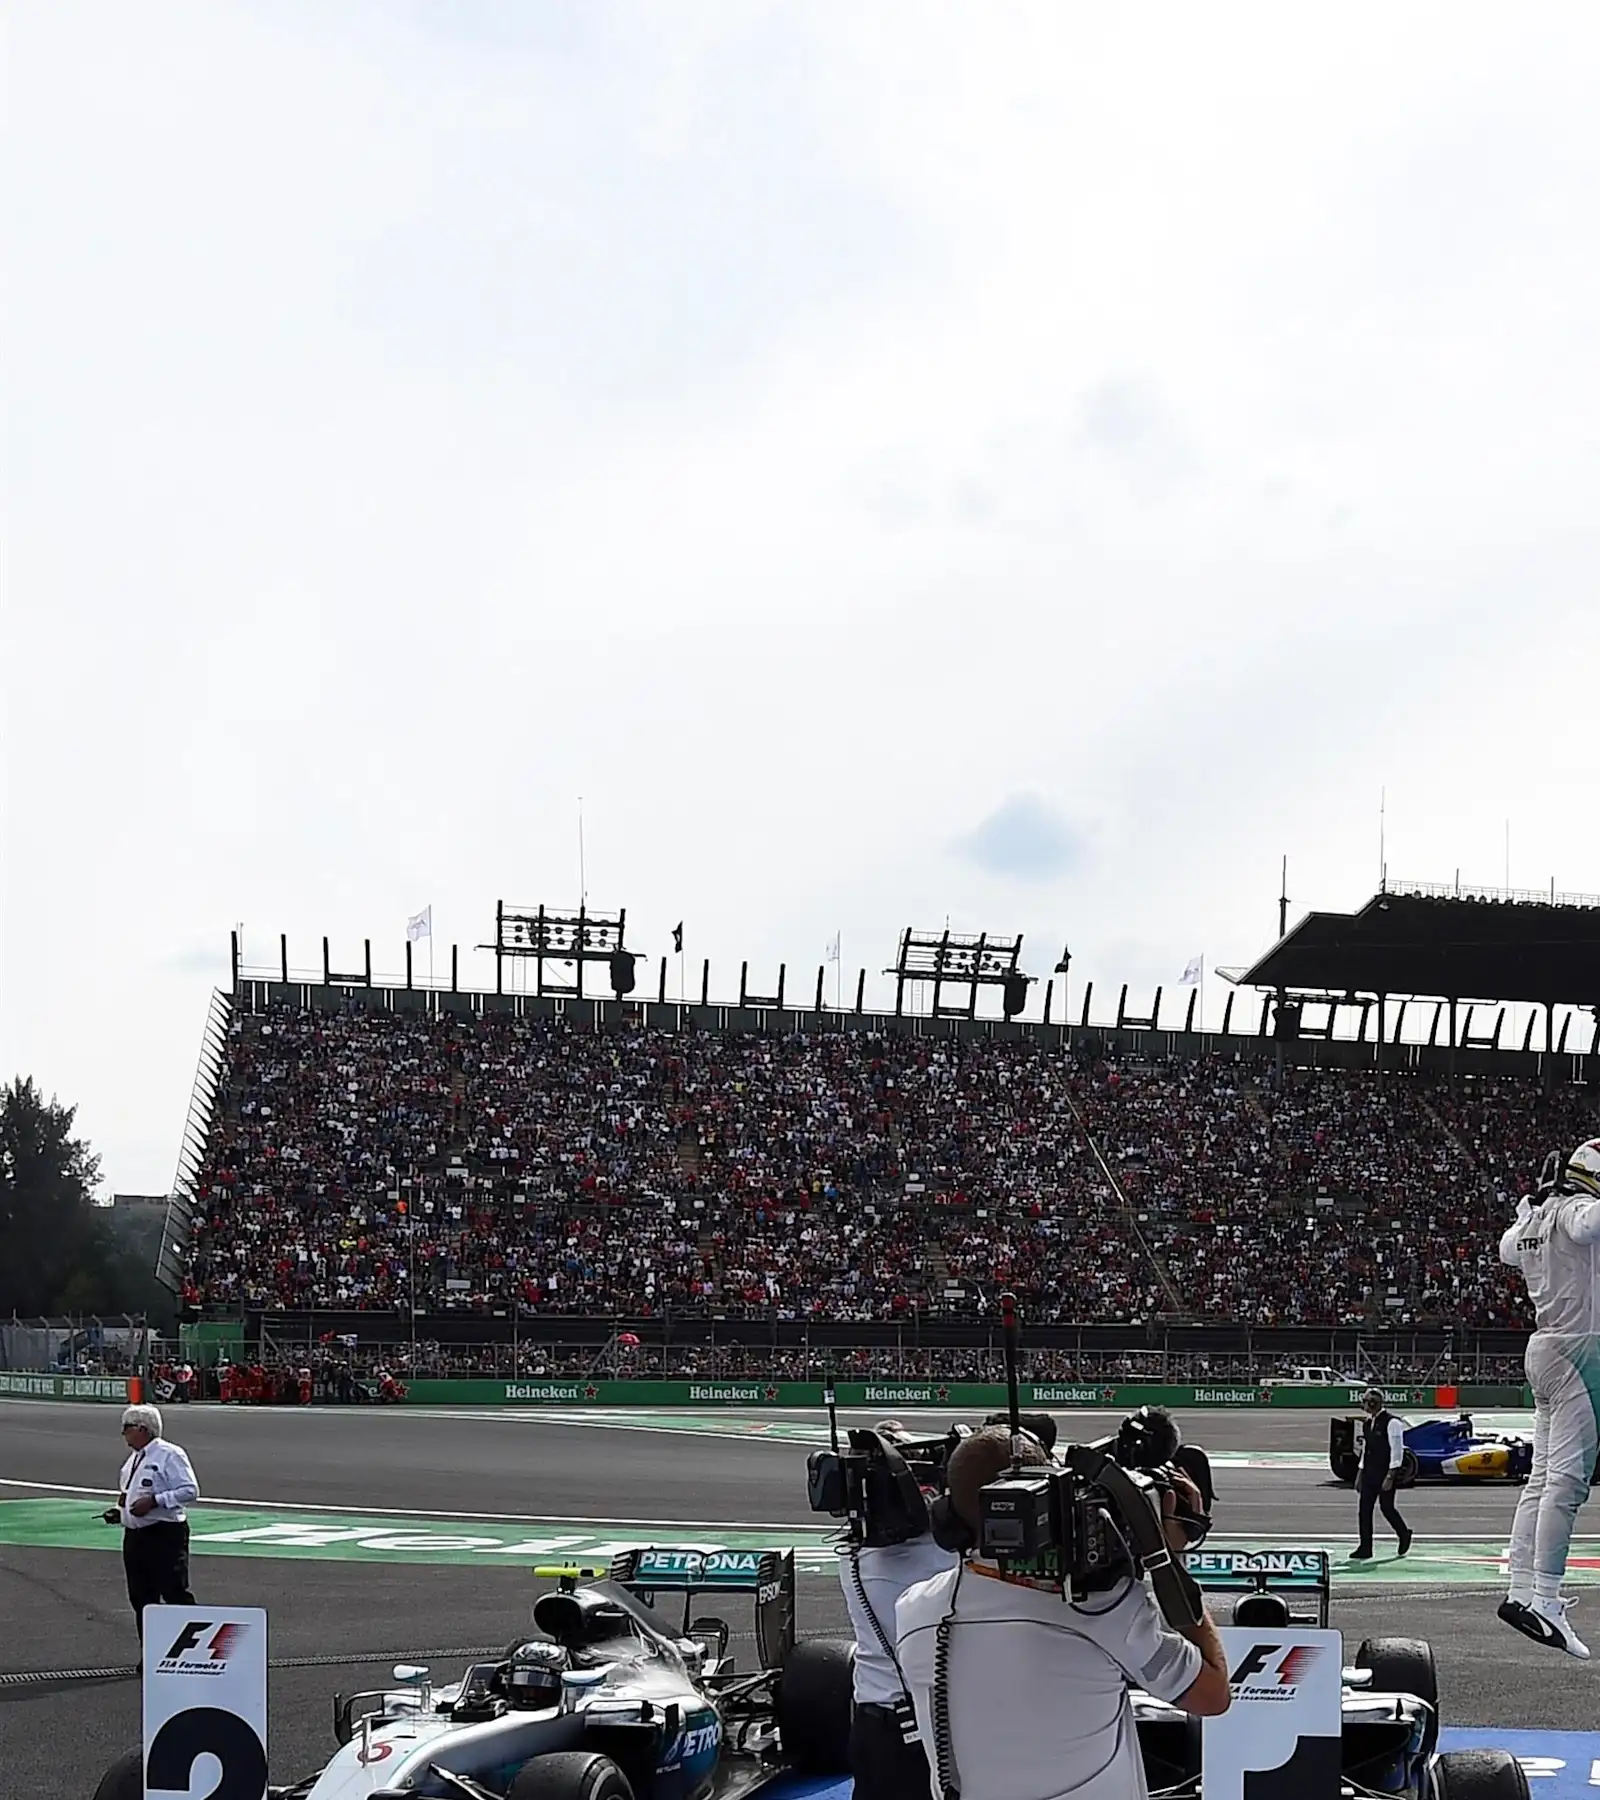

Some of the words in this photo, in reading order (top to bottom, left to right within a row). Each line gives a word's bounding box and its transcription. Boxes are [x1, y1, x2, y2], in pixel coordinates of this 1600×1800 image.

[505, 1384, 577, 1398] Heineken
[689, 1386, 758, 1399] Heineken
[865, 1386, 931, 1399] Heineken
[1033, 1387, 1096, 1400] Heineken
[1194, 1389, 1255, 1401] Heineken
[1348, 1389, 1408, 1402] Heken
[1184, 1553, 1320, 1571] PETRONAS
[165, 1622, 251, 1660] F1
[159, 1660, 176, 1669] FIA
[1229, 1645, 1326, 1684] F1
